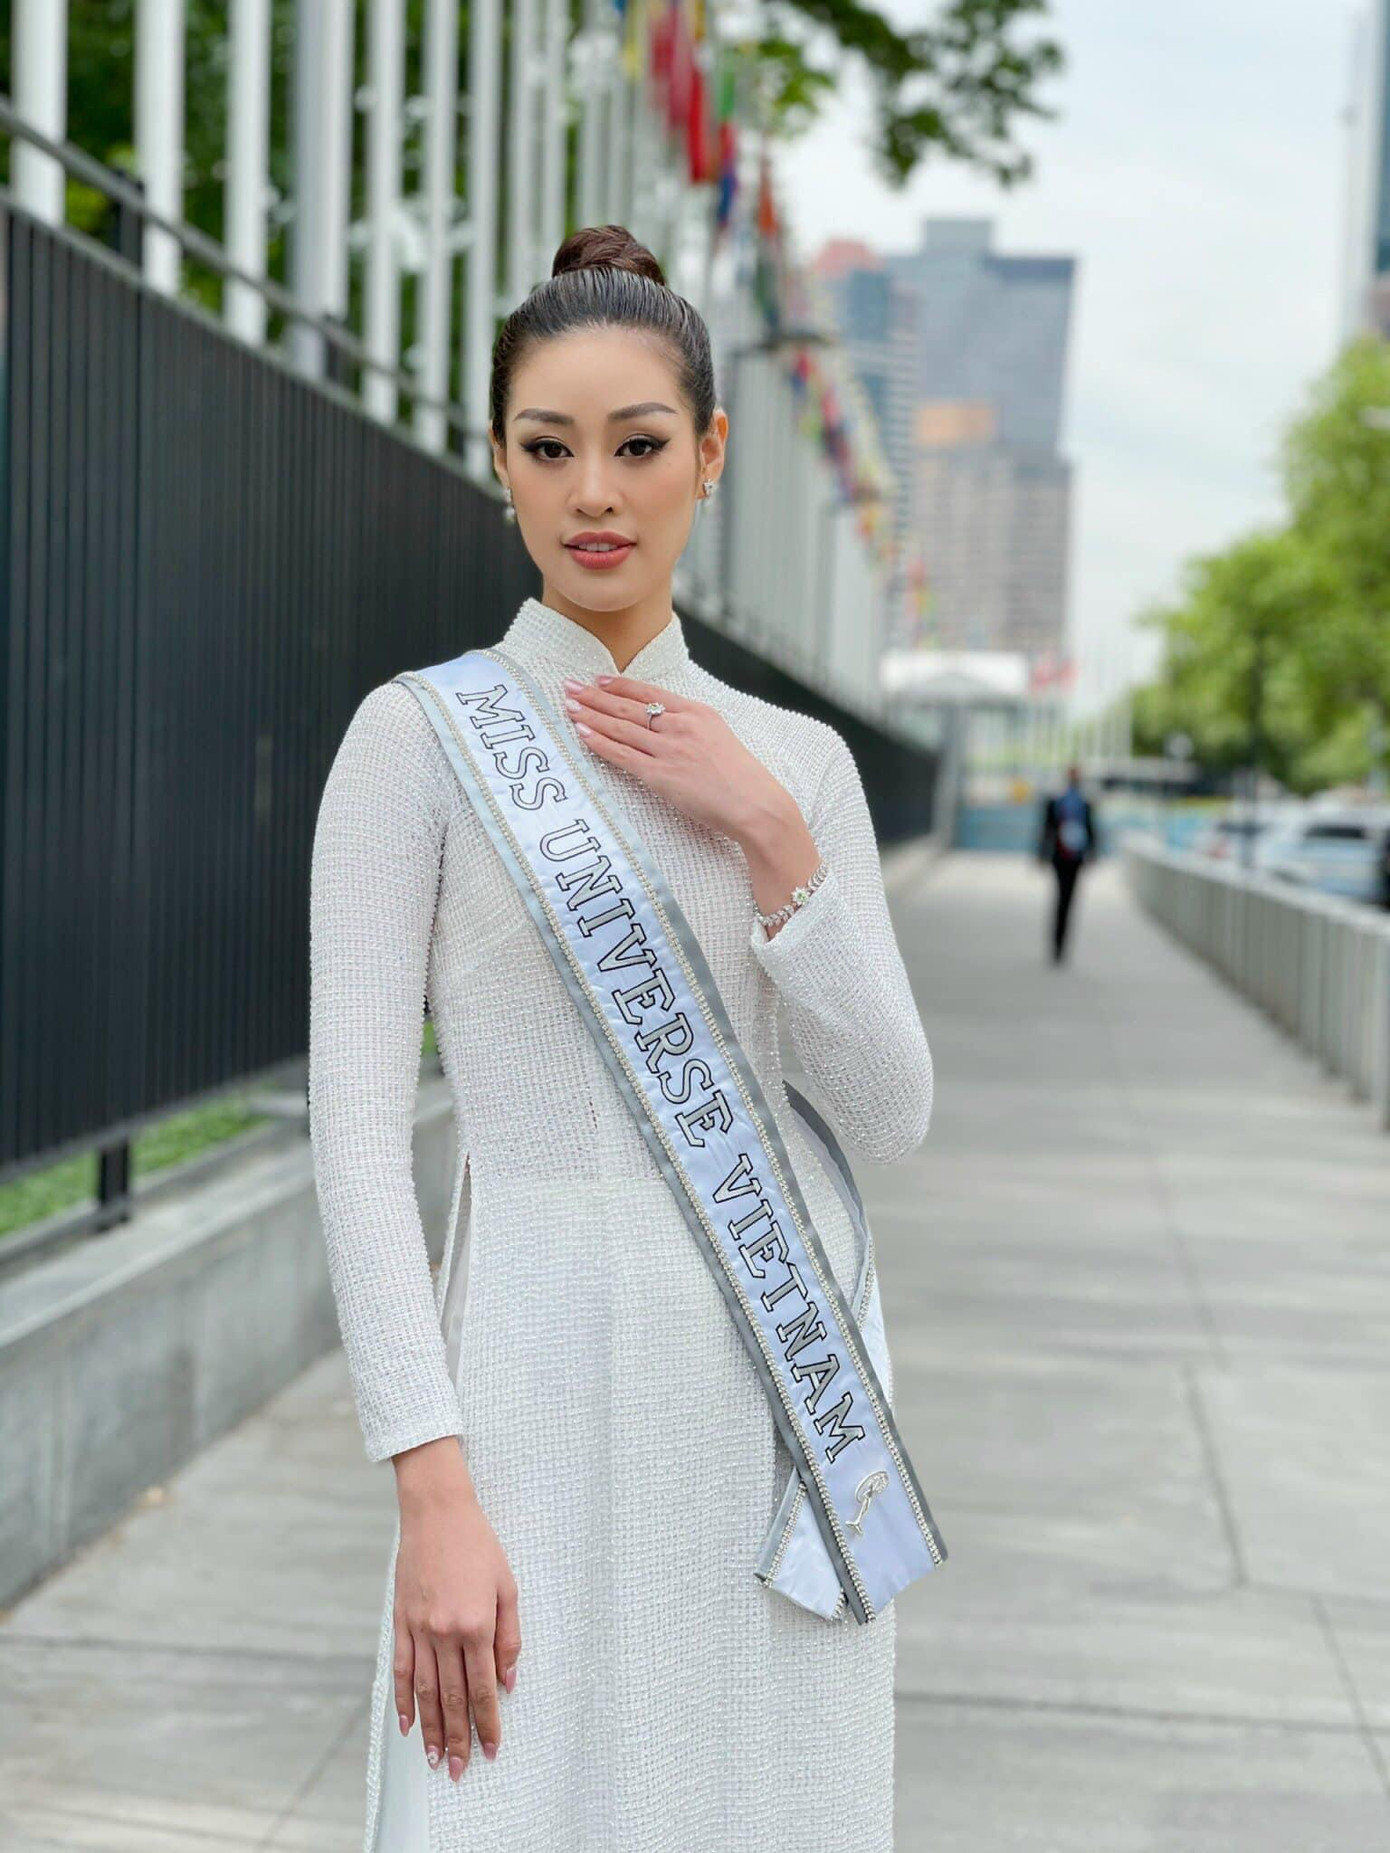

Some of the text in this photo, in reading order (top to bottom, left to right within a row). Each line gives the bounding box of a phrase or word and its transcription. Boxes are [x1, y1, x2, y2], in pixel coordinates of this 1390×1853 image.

[455, 683, 866, 1464] MISS UNIVERSE VIETNAM
